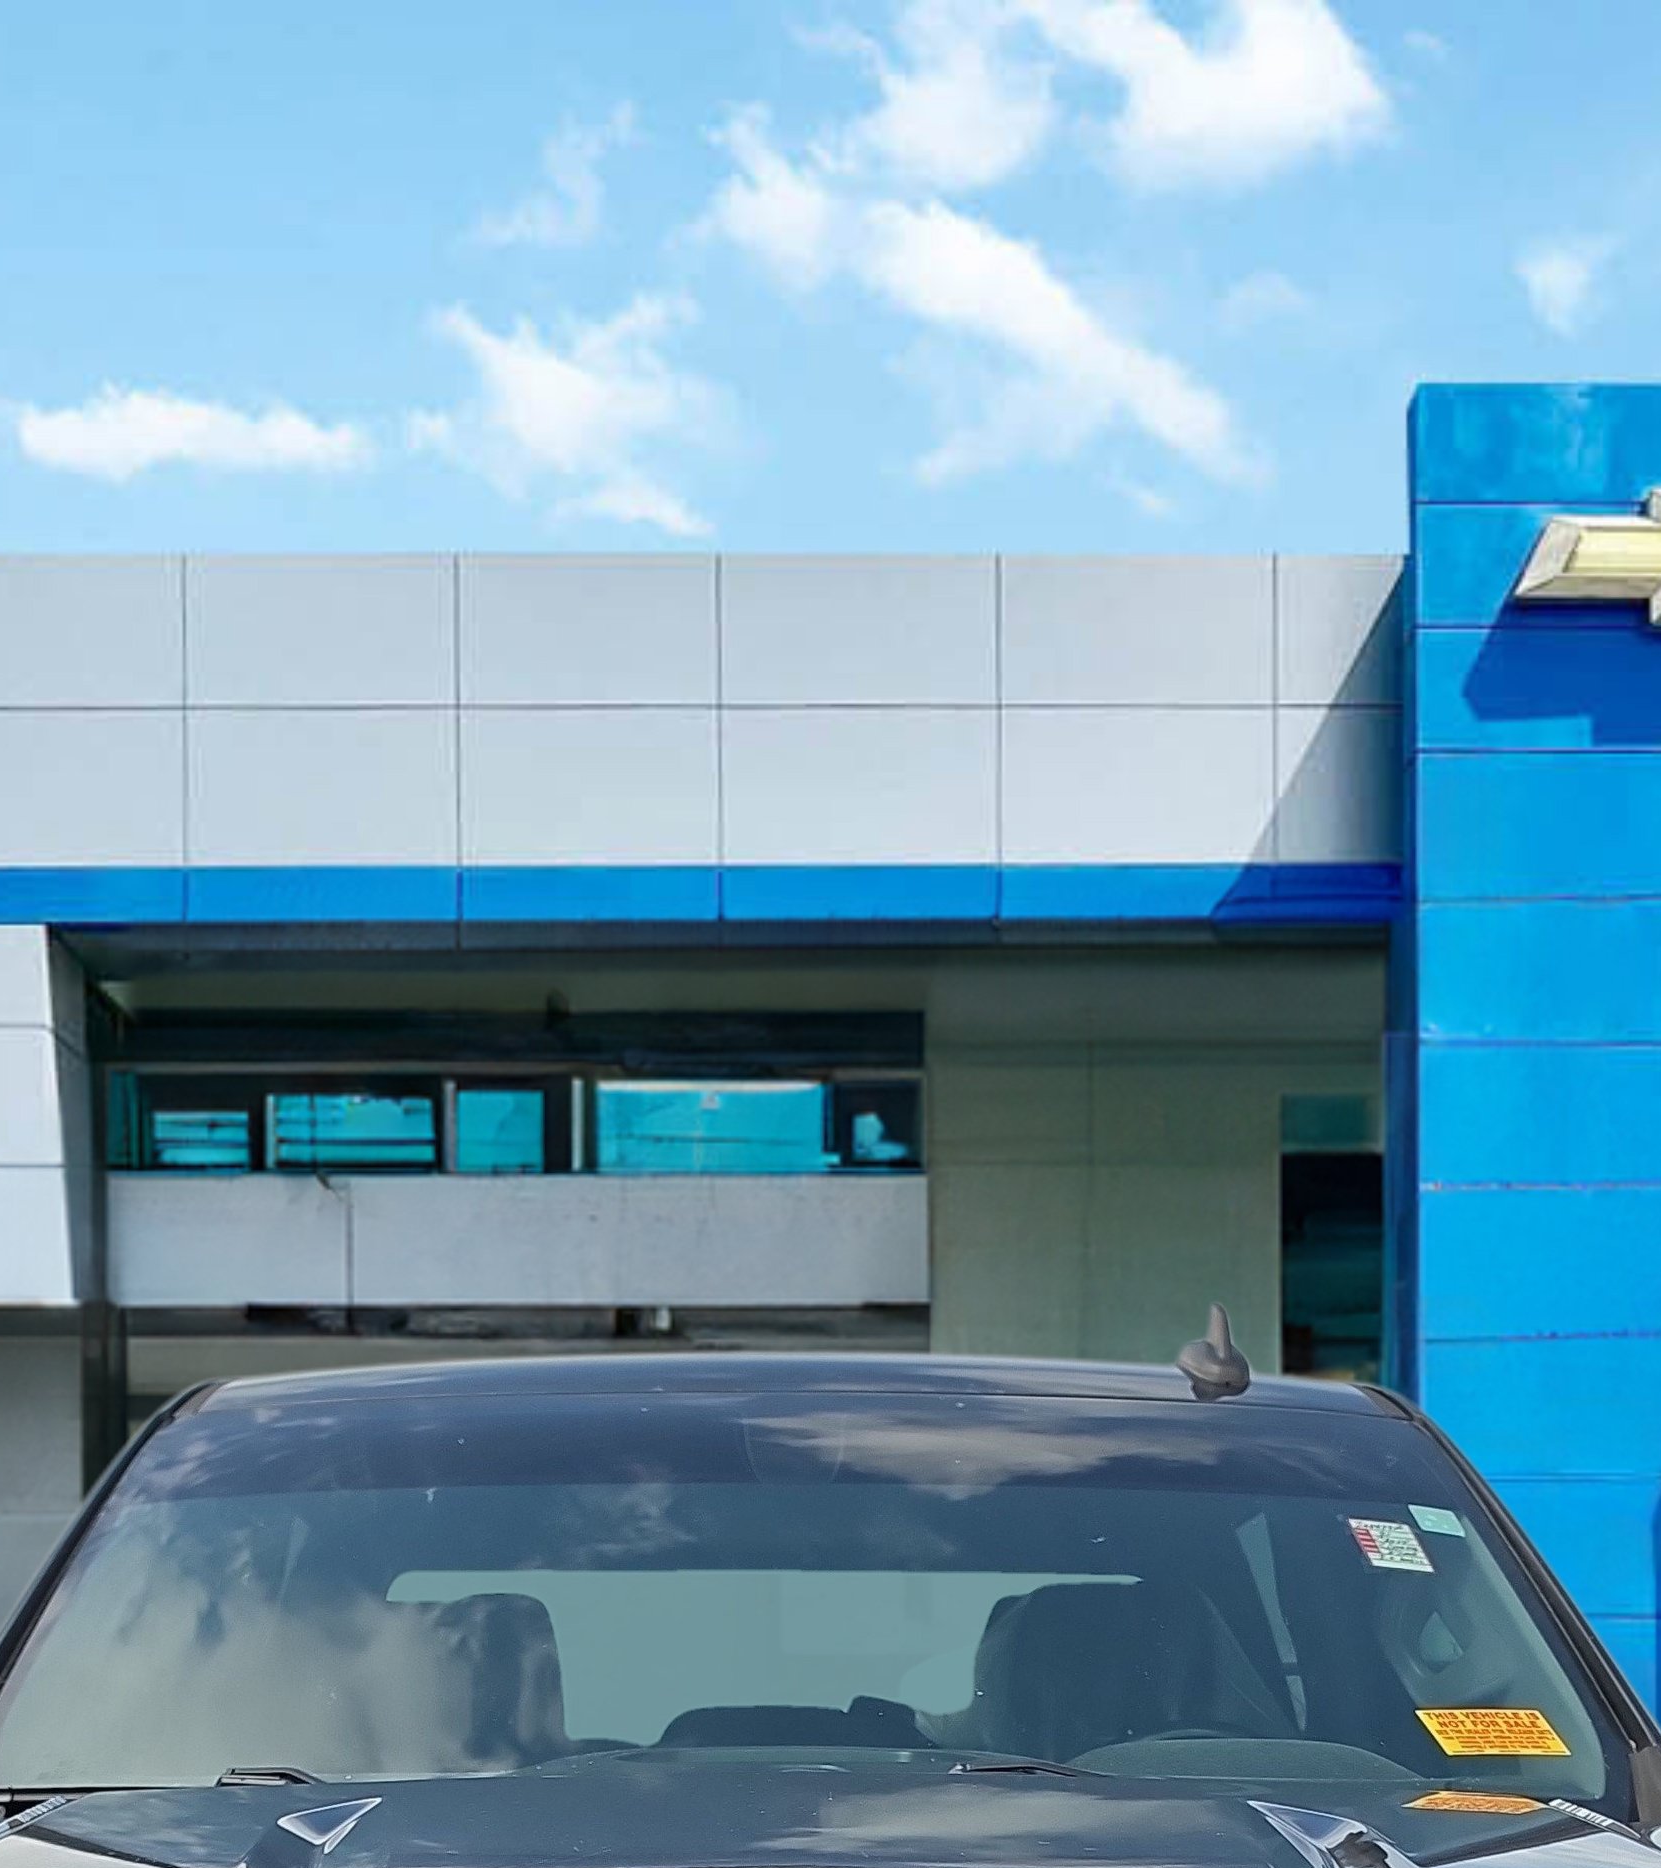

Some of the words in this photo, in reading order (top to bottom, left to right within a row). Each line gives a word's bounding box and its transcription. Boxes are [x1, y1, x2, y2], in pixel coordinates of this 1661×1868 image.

[1424, 1711, 1459, 1720] THIS
[1460, 1711, 1523, 1720] VEHICLE
[1523, 1711, 1540, 1720] IS
[1438, 1720, 1467, 1729] NOT
[1471, 1720, 1502, 1729] FOR
[1503, 1720, 1541, 1729] SALE
